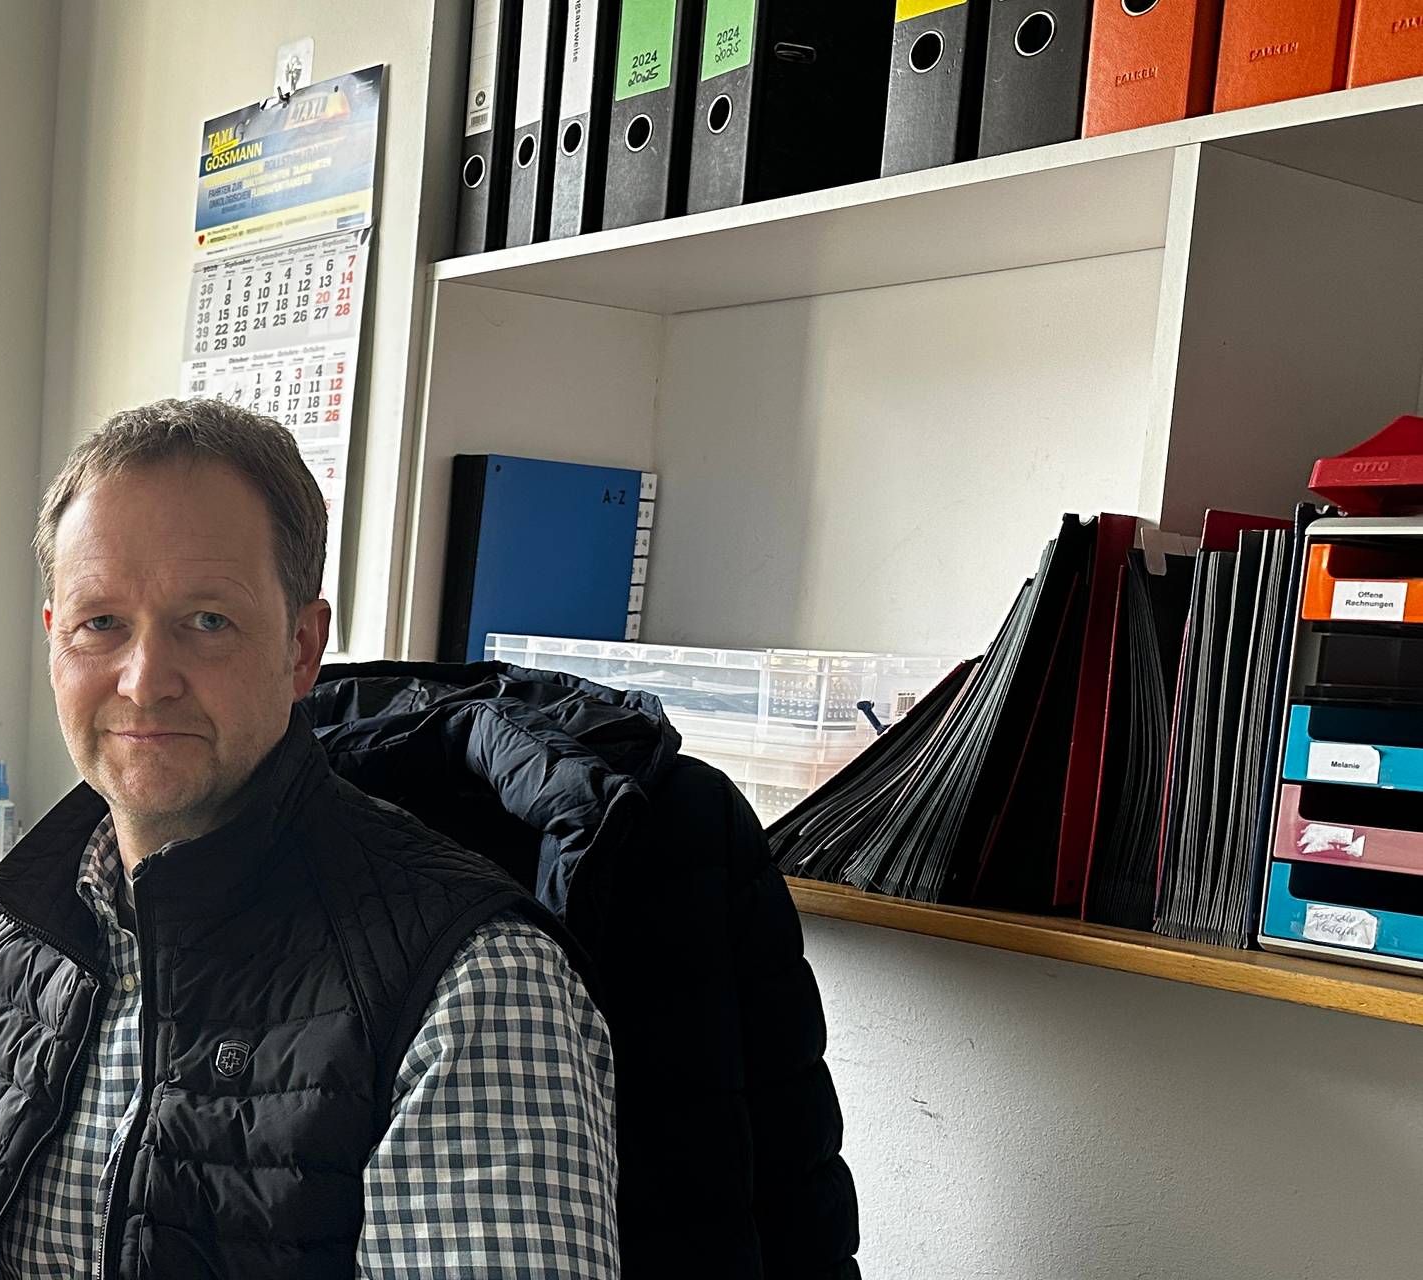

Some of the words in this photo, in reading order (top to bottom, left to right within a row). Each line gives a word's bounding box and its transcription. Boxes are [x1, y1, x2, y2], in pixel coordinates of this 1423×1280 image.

[716, 25, 740, 46] 2024
[632, 50, 658, 69] 2024
[714, 39, 741, 63] 2025
[1249, 41, 1299, 62] FALKEN
[627, 63, 661, 87] 2025
[1114, 66, 1159, 88] FALKEN
[208, 127, 234, 150] TAXI
[205, 141, 263, 172] GOSSMANN
[224, 258, 252, 270] September
[201, 284, 213, 295] 36
[227, 280, 232, 291] 1
[245, 276, 252, 287] 2
[264, 272, 271, 283] 3
[285, 268, 291, 279] 4
[305, 264, 312, 275] 5
[327, 260, 334, 271] 6
[348, 256, 356, 267] 7
[199, 300, 211, 310] 37
[224, 294, 231, 305] 8
[243, 291, 250, 302] 9
[258, 287, 270, 299] 10
[278, 283, 288, 295] 11
[298, 279, 310, 292] 12
[319, 275, 331, 288] 13
[341, 272, 353, 284] 14
[197, 313, 210, 324] 38
[219, 309, 229, 320] 15
[238, 305, 248, 317] 16
[257, 302, 268, 314] 17
[277, 299, 288, 311] 18
[297, 295, 309, 307] 19
[316, 291, 330, 304] 20
[338, 288, 350, 300] 21
[196, 327, 209, 338] 39
[216, 324, 228, 336] 22
[234, 320, 247, 333] 23
[254, 317, 266, 329] 24
[273, 314, 286, 326] 25
[293, 310, 307, 323] 26
[314, 307, 328, 320] 27
[335, 304, 350, 316] 28
[195, 342, 208, 353] 40
[214, 339, 227, 350] 29
[233, 335, 246, 347] 30
[192, 380, 205, 392] 40
[256, 373, 261, 384] 1
[275, 371, 282, 382] 2
[295, 368, 302, 379] 3
[316, 365, 322, 376] 4
[337, 362, 344, 374] 5
[235, 390, 242, 401] 7
[254, 388, 261, 399] 8
[274, 386, 280, 397] 9
[289, 383, 300, 395] 10
[309, 381, 320, 392] 11
[330, 378, 342, 390] 12
[268, 402, 279, 412] 16
[288, 399, 299, 410] 17
[308, 397, 320, 408] 18
[328, 394, 341, 406] 19
[285, 414, 297, 425] 24
[304, 412, 318, 424] 25
[326, 410, 339, 422] 26
[327, 468, 334, 478] 2
[1353, 461, 1389, 472] OTTO
[603, 489, 625, 504] A-Z
[1345, 600, 1394, 609] Rechnungen
[1331, 761, 1360, 769] Melanie
